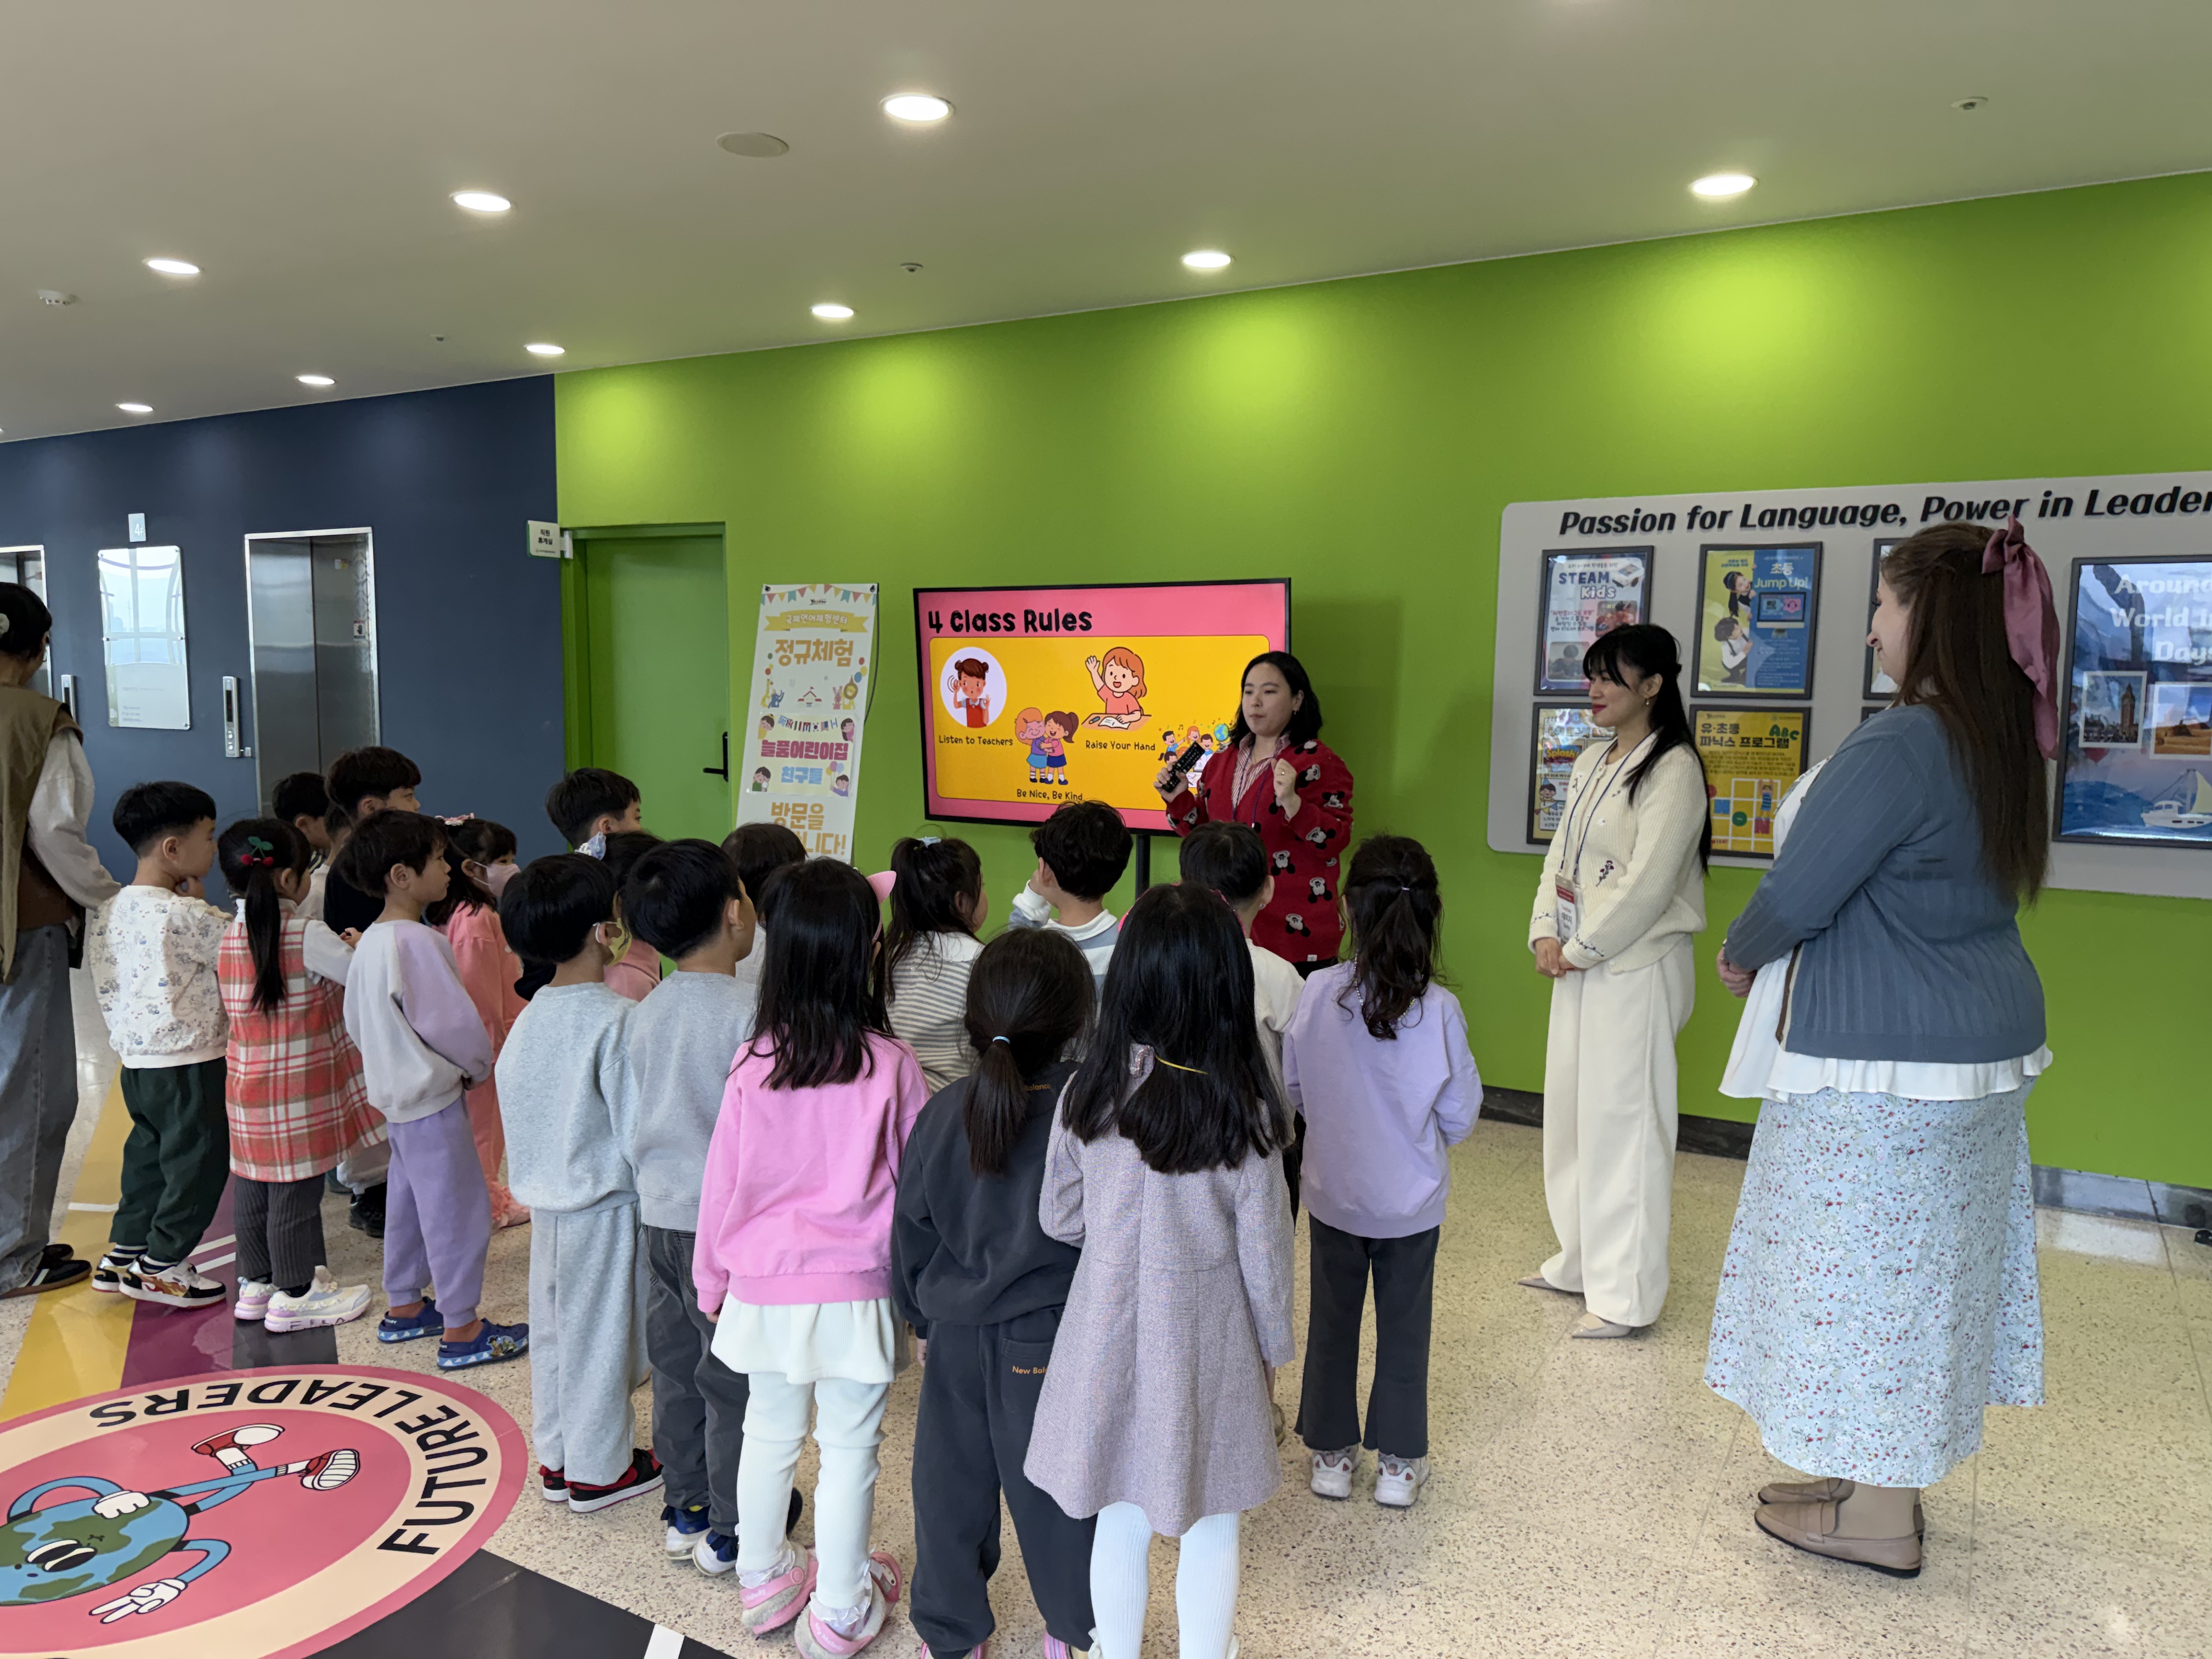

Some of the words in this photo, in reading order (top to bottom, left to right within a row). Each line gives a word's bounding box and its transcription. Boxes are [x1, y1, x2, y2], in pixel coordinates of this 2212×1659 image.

[1559, 508, 1676, 535] Passion
[1687, 505, 1733, 529] for
[1740, 504, 1907, 529] Language,
[1920, 496, 2030, 522] Power
[2038, 490, 2073, 518] in
[134, 523, 144, 537] 4F
[538, 537, 553, 545] 휴게실
[1770, 563, 1794, 575] 초등
[1559, 572, 1609, 585] STEAM
[1754, 578, 1787, 590] Jump
[1790, 577, 1808, 590] Up!
[1581, 585, 1616, 600] Kids
[786, 614, 848, 624] 국제언어체험센터
[928, 610, 943, 633] 4
[950, 610, 1015, 633] Class
[1024, 608, 1092, 633] Rules
[2109, 607, 2189, 627] World
[775, 639, 854, 667] 정규체험
[1701, 723, 1740, 735] 유·초등
[1769, 724, 1800, 741] ABC
[939, 735, 963, 744] Listen
[966, 736, 975, 744] to
[978, 736, 1013, 746] Teachers
[1086, 740, 1108, 750] Raise
[1110, 741, 1131, 750] Your
[1134, 741, 1156, 751] Hand
[1700, 736, 1735, 747] 파닉스
[1740, 737, 1789, 749] 프로그램
[761, 740, 849, 760] 늘품어린이집
[1545, 747, 1580, 760] Splash!
[781, 766, 823, 785] 친구들
[1017, 789, 1028, 798] Be
[1029, 790, 1049, 799] Nice,
[1052, 791, 1062, 799] Be
[1065, 792, 1083, 800] Kind
[771, 802, 825, 831] 방문을
[1012, 1365, 1030, 1374] New
[89, 1379, 423, 1427] LEADERS
[377, 1404, 488, 1555] FUTURE
